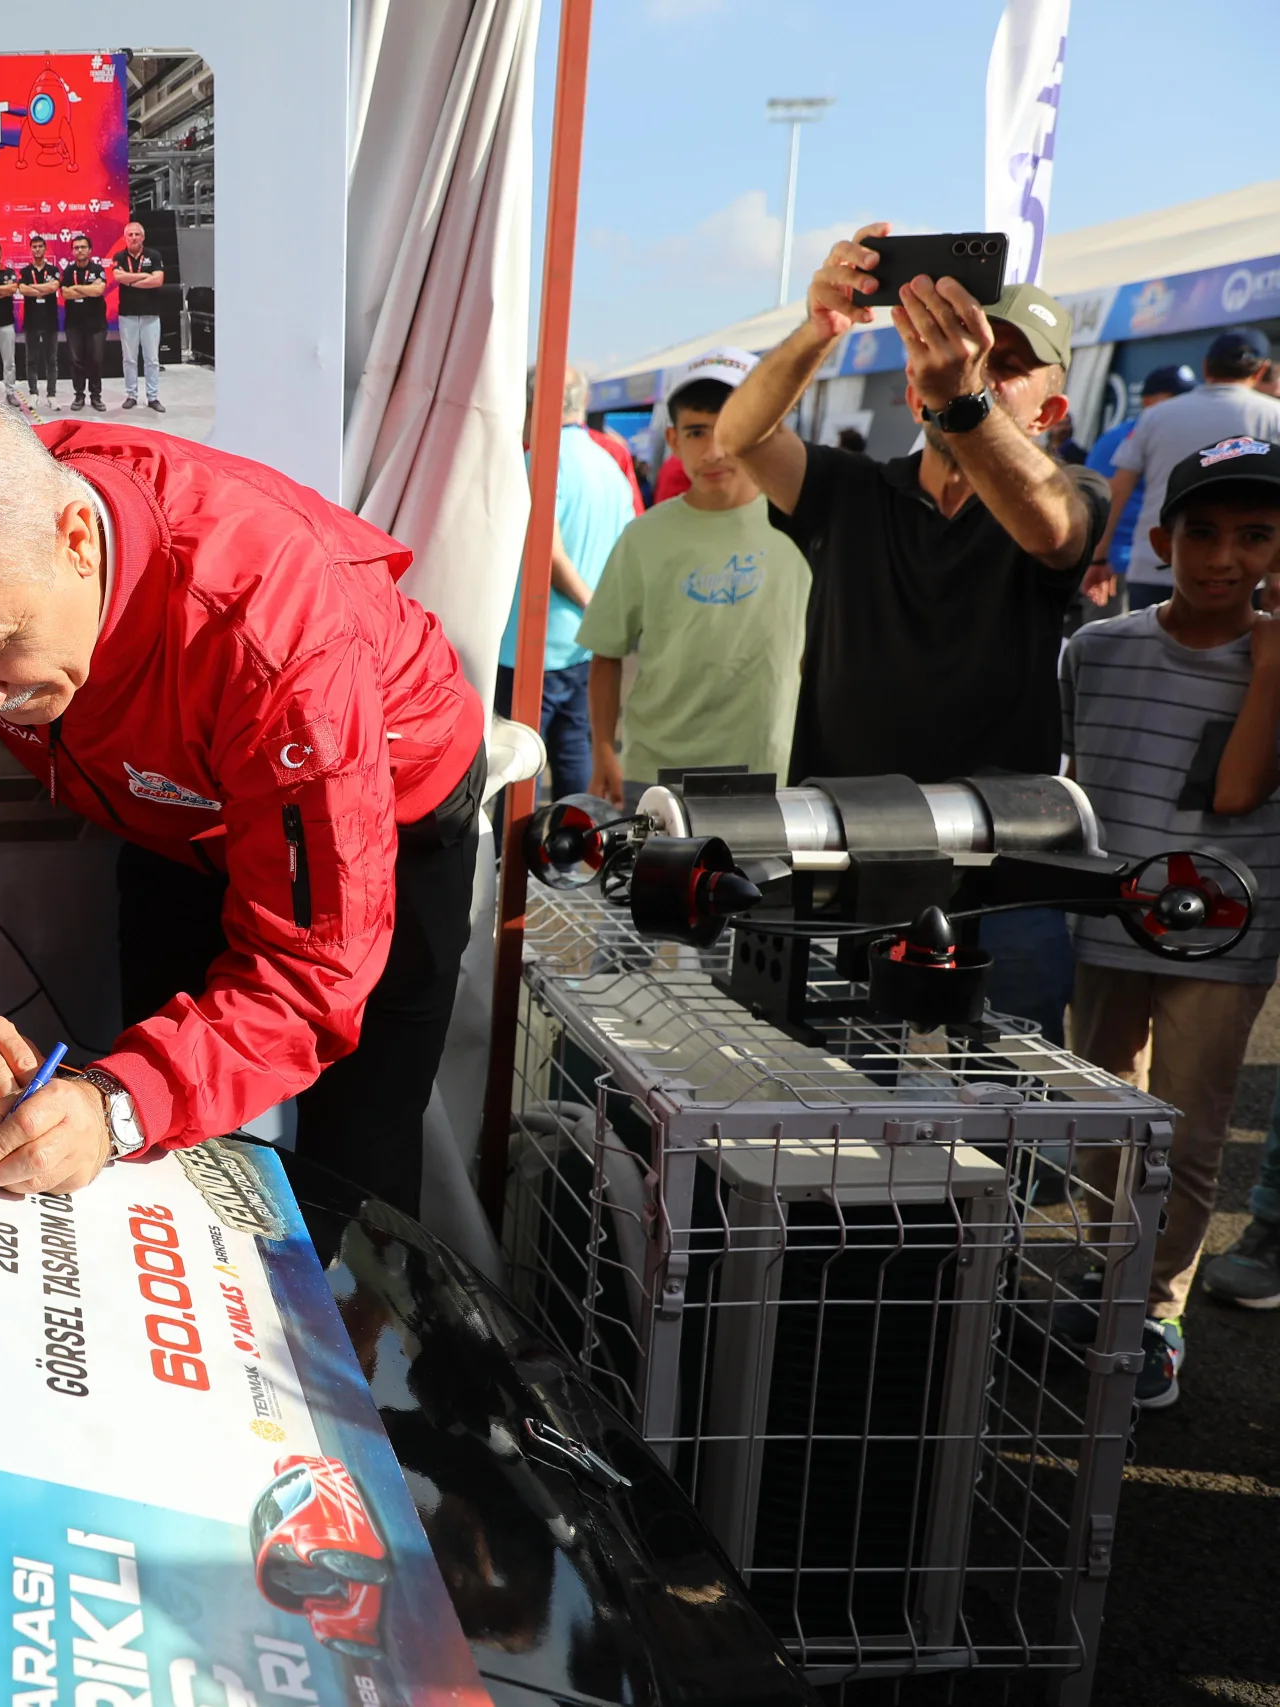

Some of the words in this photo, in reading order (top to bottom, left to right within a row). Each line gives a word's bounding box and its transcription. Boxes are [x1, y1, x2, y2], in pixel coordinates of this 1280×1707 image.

[218, 1155, 274, 1219] GÜNEYDOĞU
[40, 1212, 81, 1298] TASARIM
[208, 1224, 229, 1264] ARKPRES
[128, 1203, 211, 1391] 60.000₺
[219, 1281, 255, 1338] ANLAS
[35, 1305, 90, 1397] GÖRSEL
[244, 1364, 270, 1418] TENMAK
[254, 1634, 321, 1707] RI
